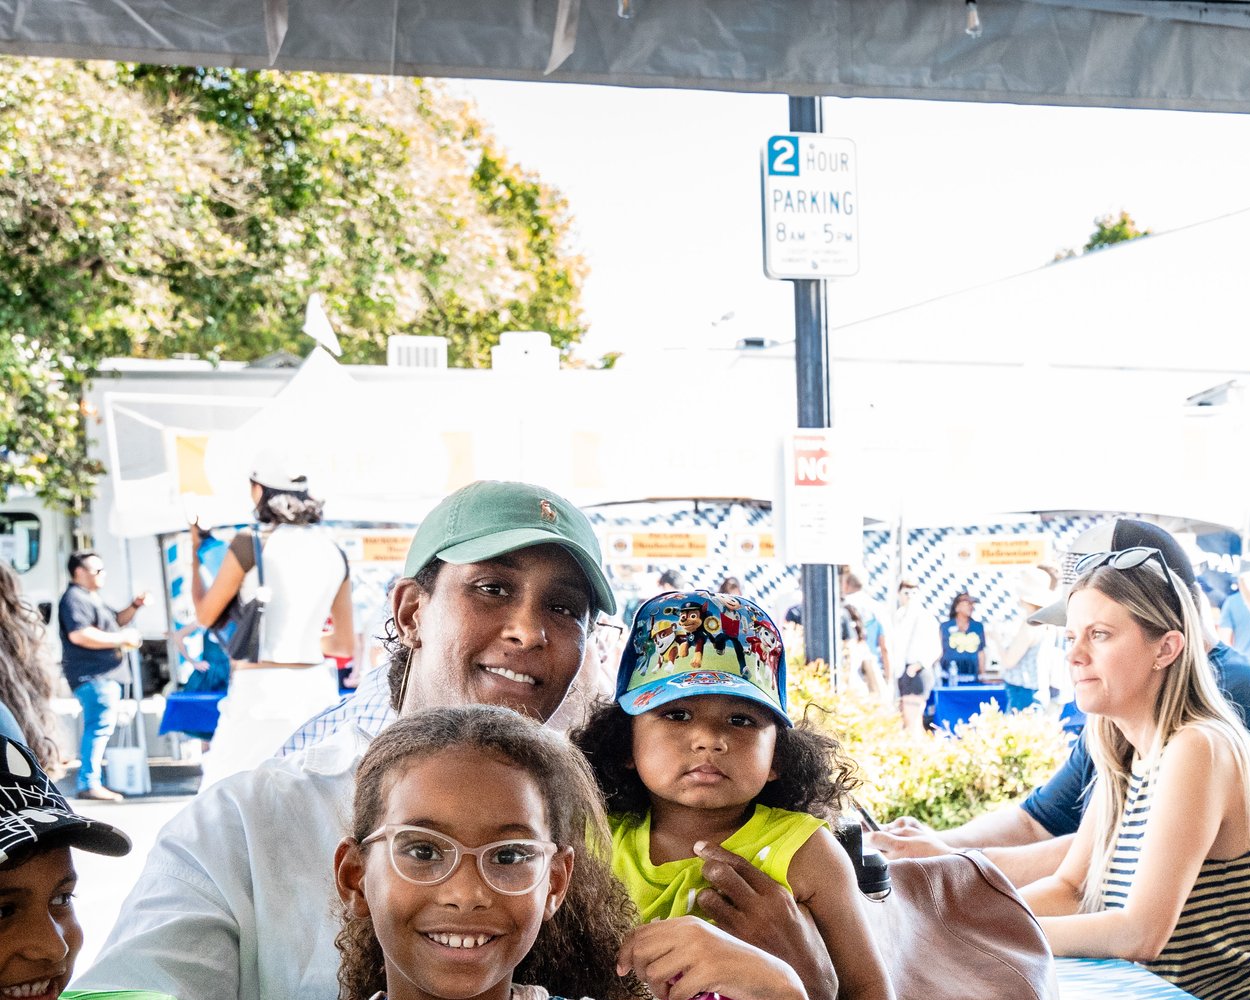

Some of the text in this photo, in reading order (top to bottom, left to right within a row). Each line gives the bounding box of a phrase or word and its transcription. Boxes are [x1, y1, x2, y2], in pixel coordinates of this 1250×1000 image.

[773, 139, 849, 172] 2 HOUR
[773, 188, 854, 216] PARKING
